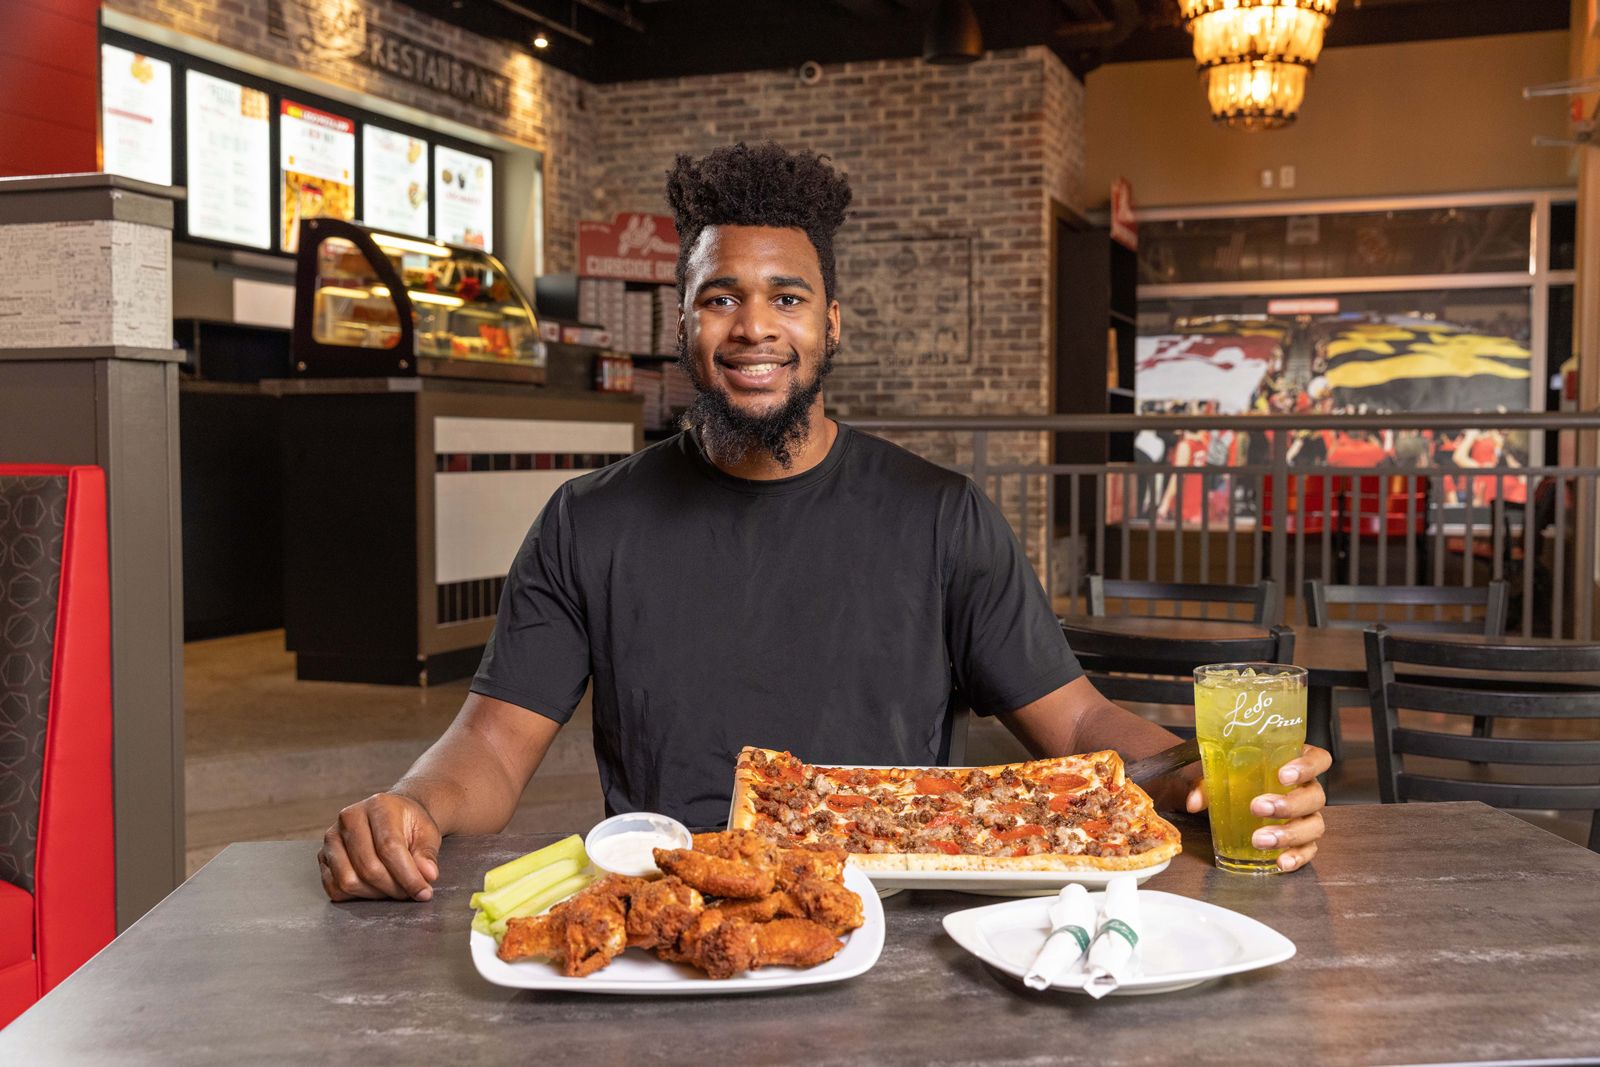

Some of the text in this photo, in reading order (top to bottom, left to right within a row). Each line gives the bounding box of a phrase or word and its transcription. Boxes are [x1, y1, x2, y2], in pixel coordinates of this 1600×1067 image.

[369, 32, 506, 111] RESTAURANT
[1223, 690, 1274, 737] Ledo
[1257, 714, 1303, 735] Pizza
